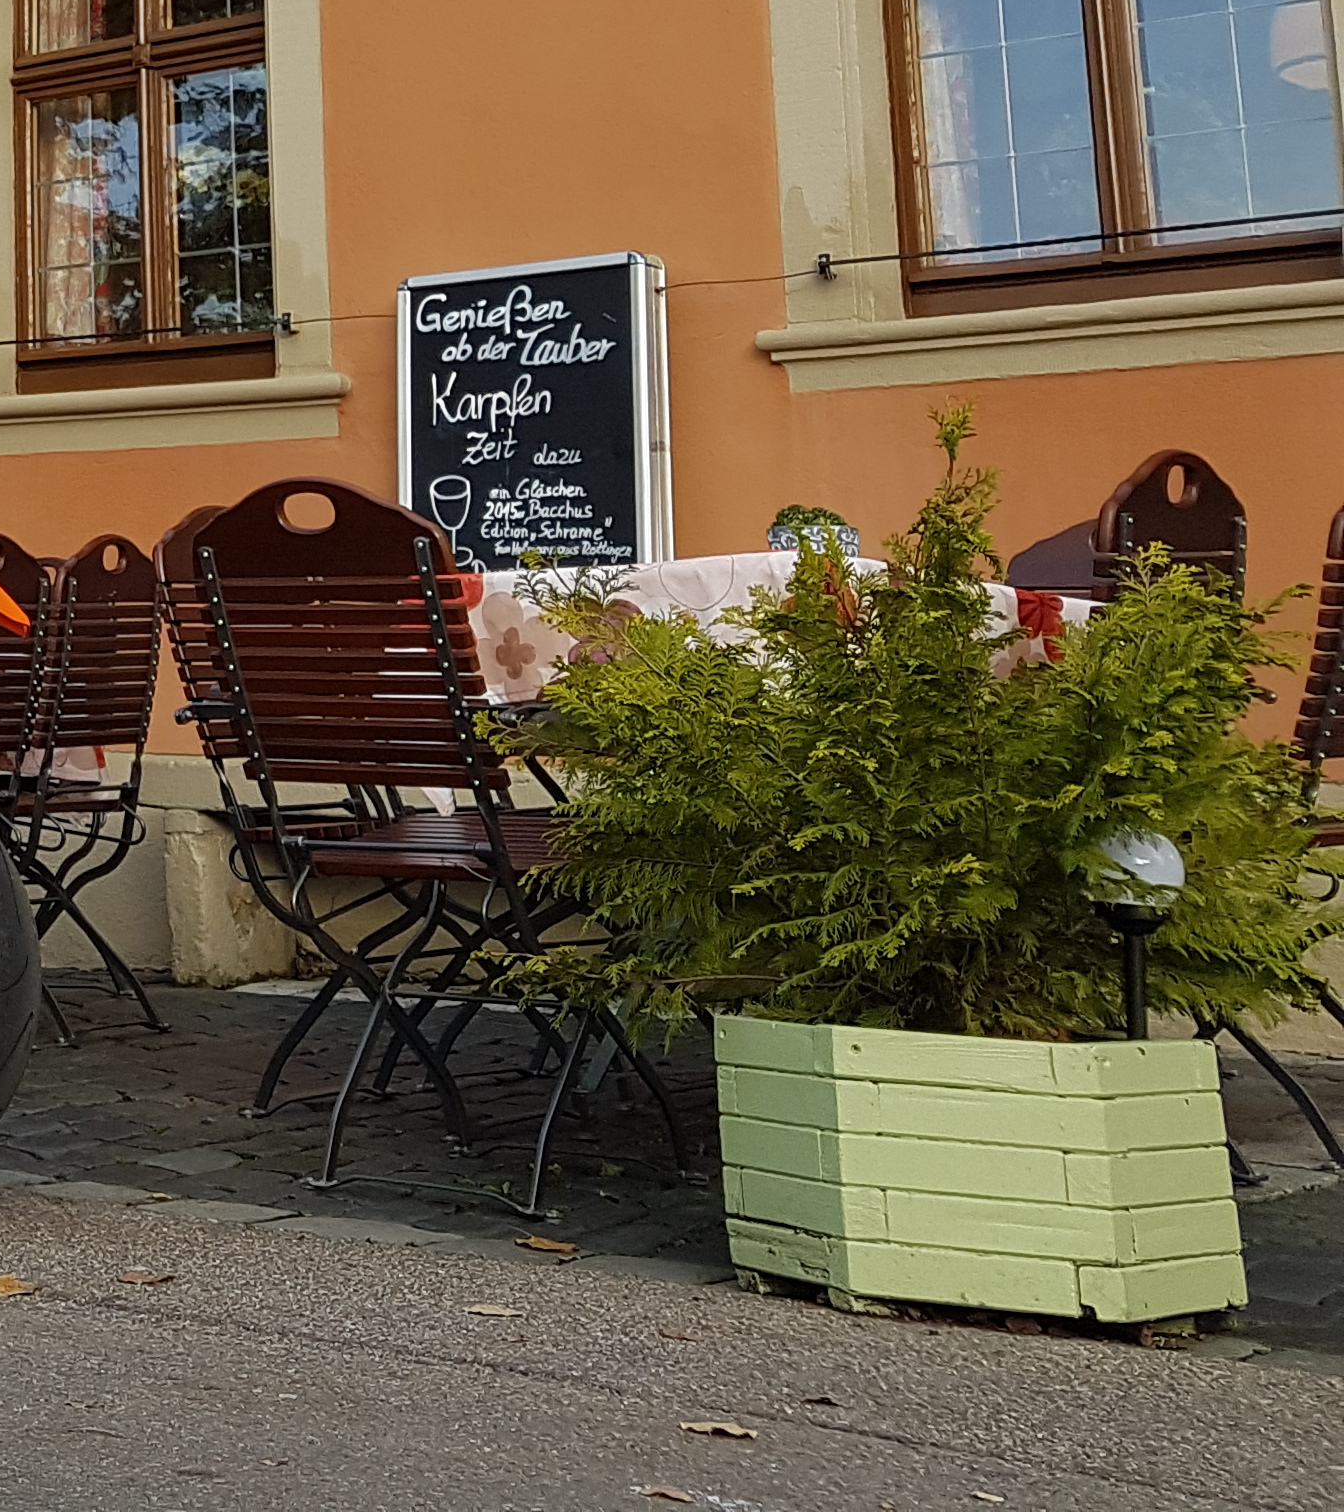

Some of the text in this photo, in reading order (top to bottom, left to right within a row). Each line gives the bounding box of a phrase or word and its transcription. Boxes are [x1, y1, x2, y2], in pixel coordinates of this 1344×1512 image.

[415, 285, 572, 334] Genießen
[441, 323, 616, 366] ob der Tauber
[431, 372, 552, 433] Karpfen
[462, 429, 518, 465] Zeit
[533, 443, 582, 466] dazu
[488, 478, 588, 499] ein Gläschen
[524, 499, 593, 525] Bacchus
